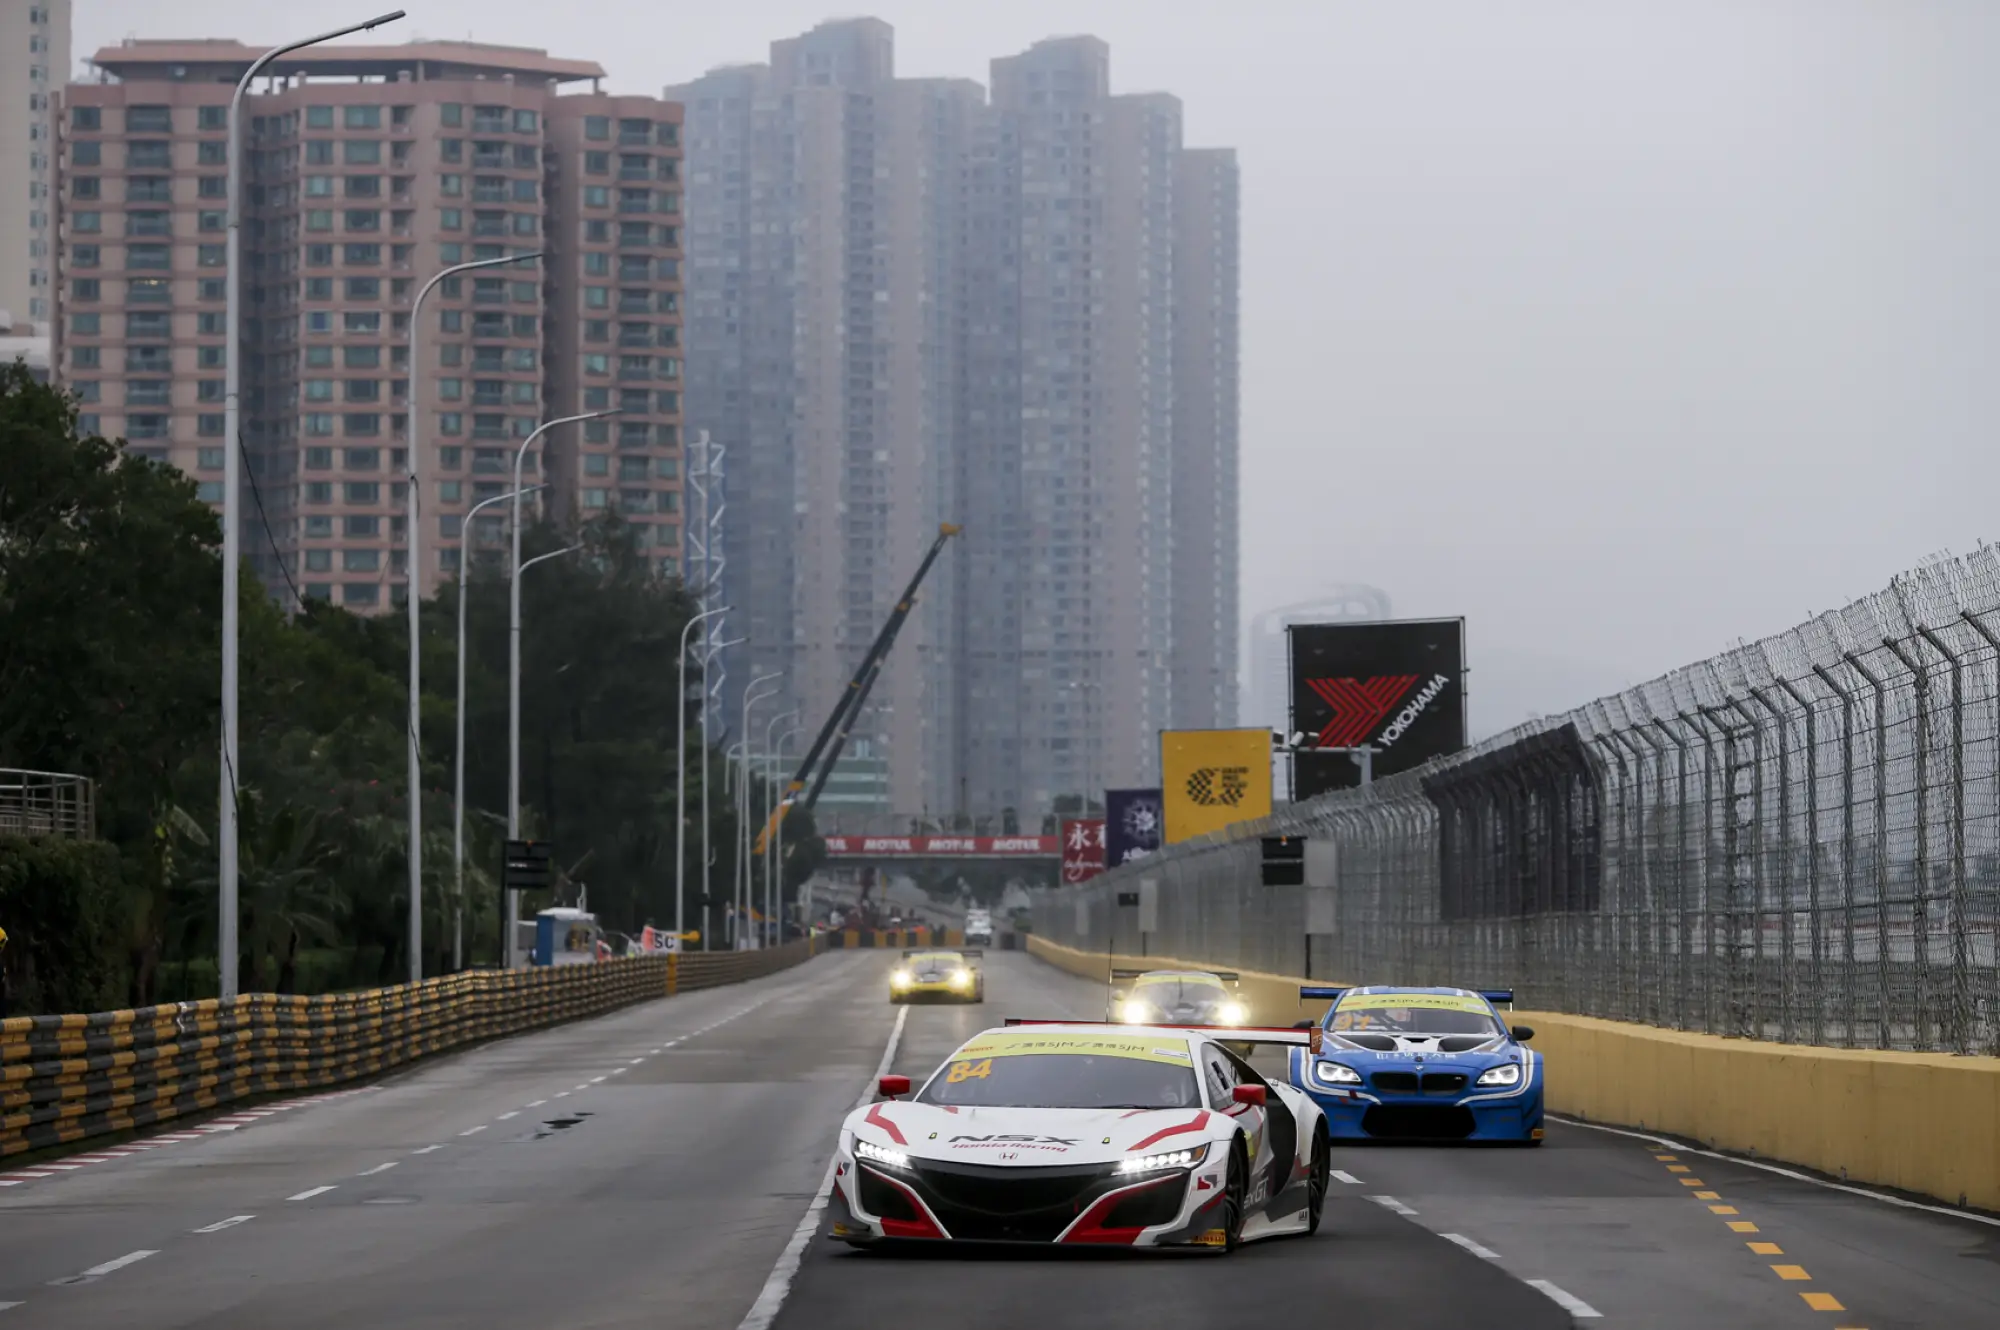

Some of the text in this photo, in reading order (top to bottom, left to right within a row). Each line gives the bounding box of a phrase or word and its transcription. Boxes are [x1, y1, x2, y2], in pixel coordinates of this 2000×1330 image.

[1377, 672, 1450, 747] YOKOHAMA
[863, 838, 911, 850] MOTUL
[928, 838, 975, 850] MOTUL
[992, 838, 1040, 850] MOTUL
[655, 932, 674, 949] SC
[946, 1059, 992, 1083] 84
[948, 1134, 1084, 1146] NSX
[1010, 1142, 1068, 1152] Racing
